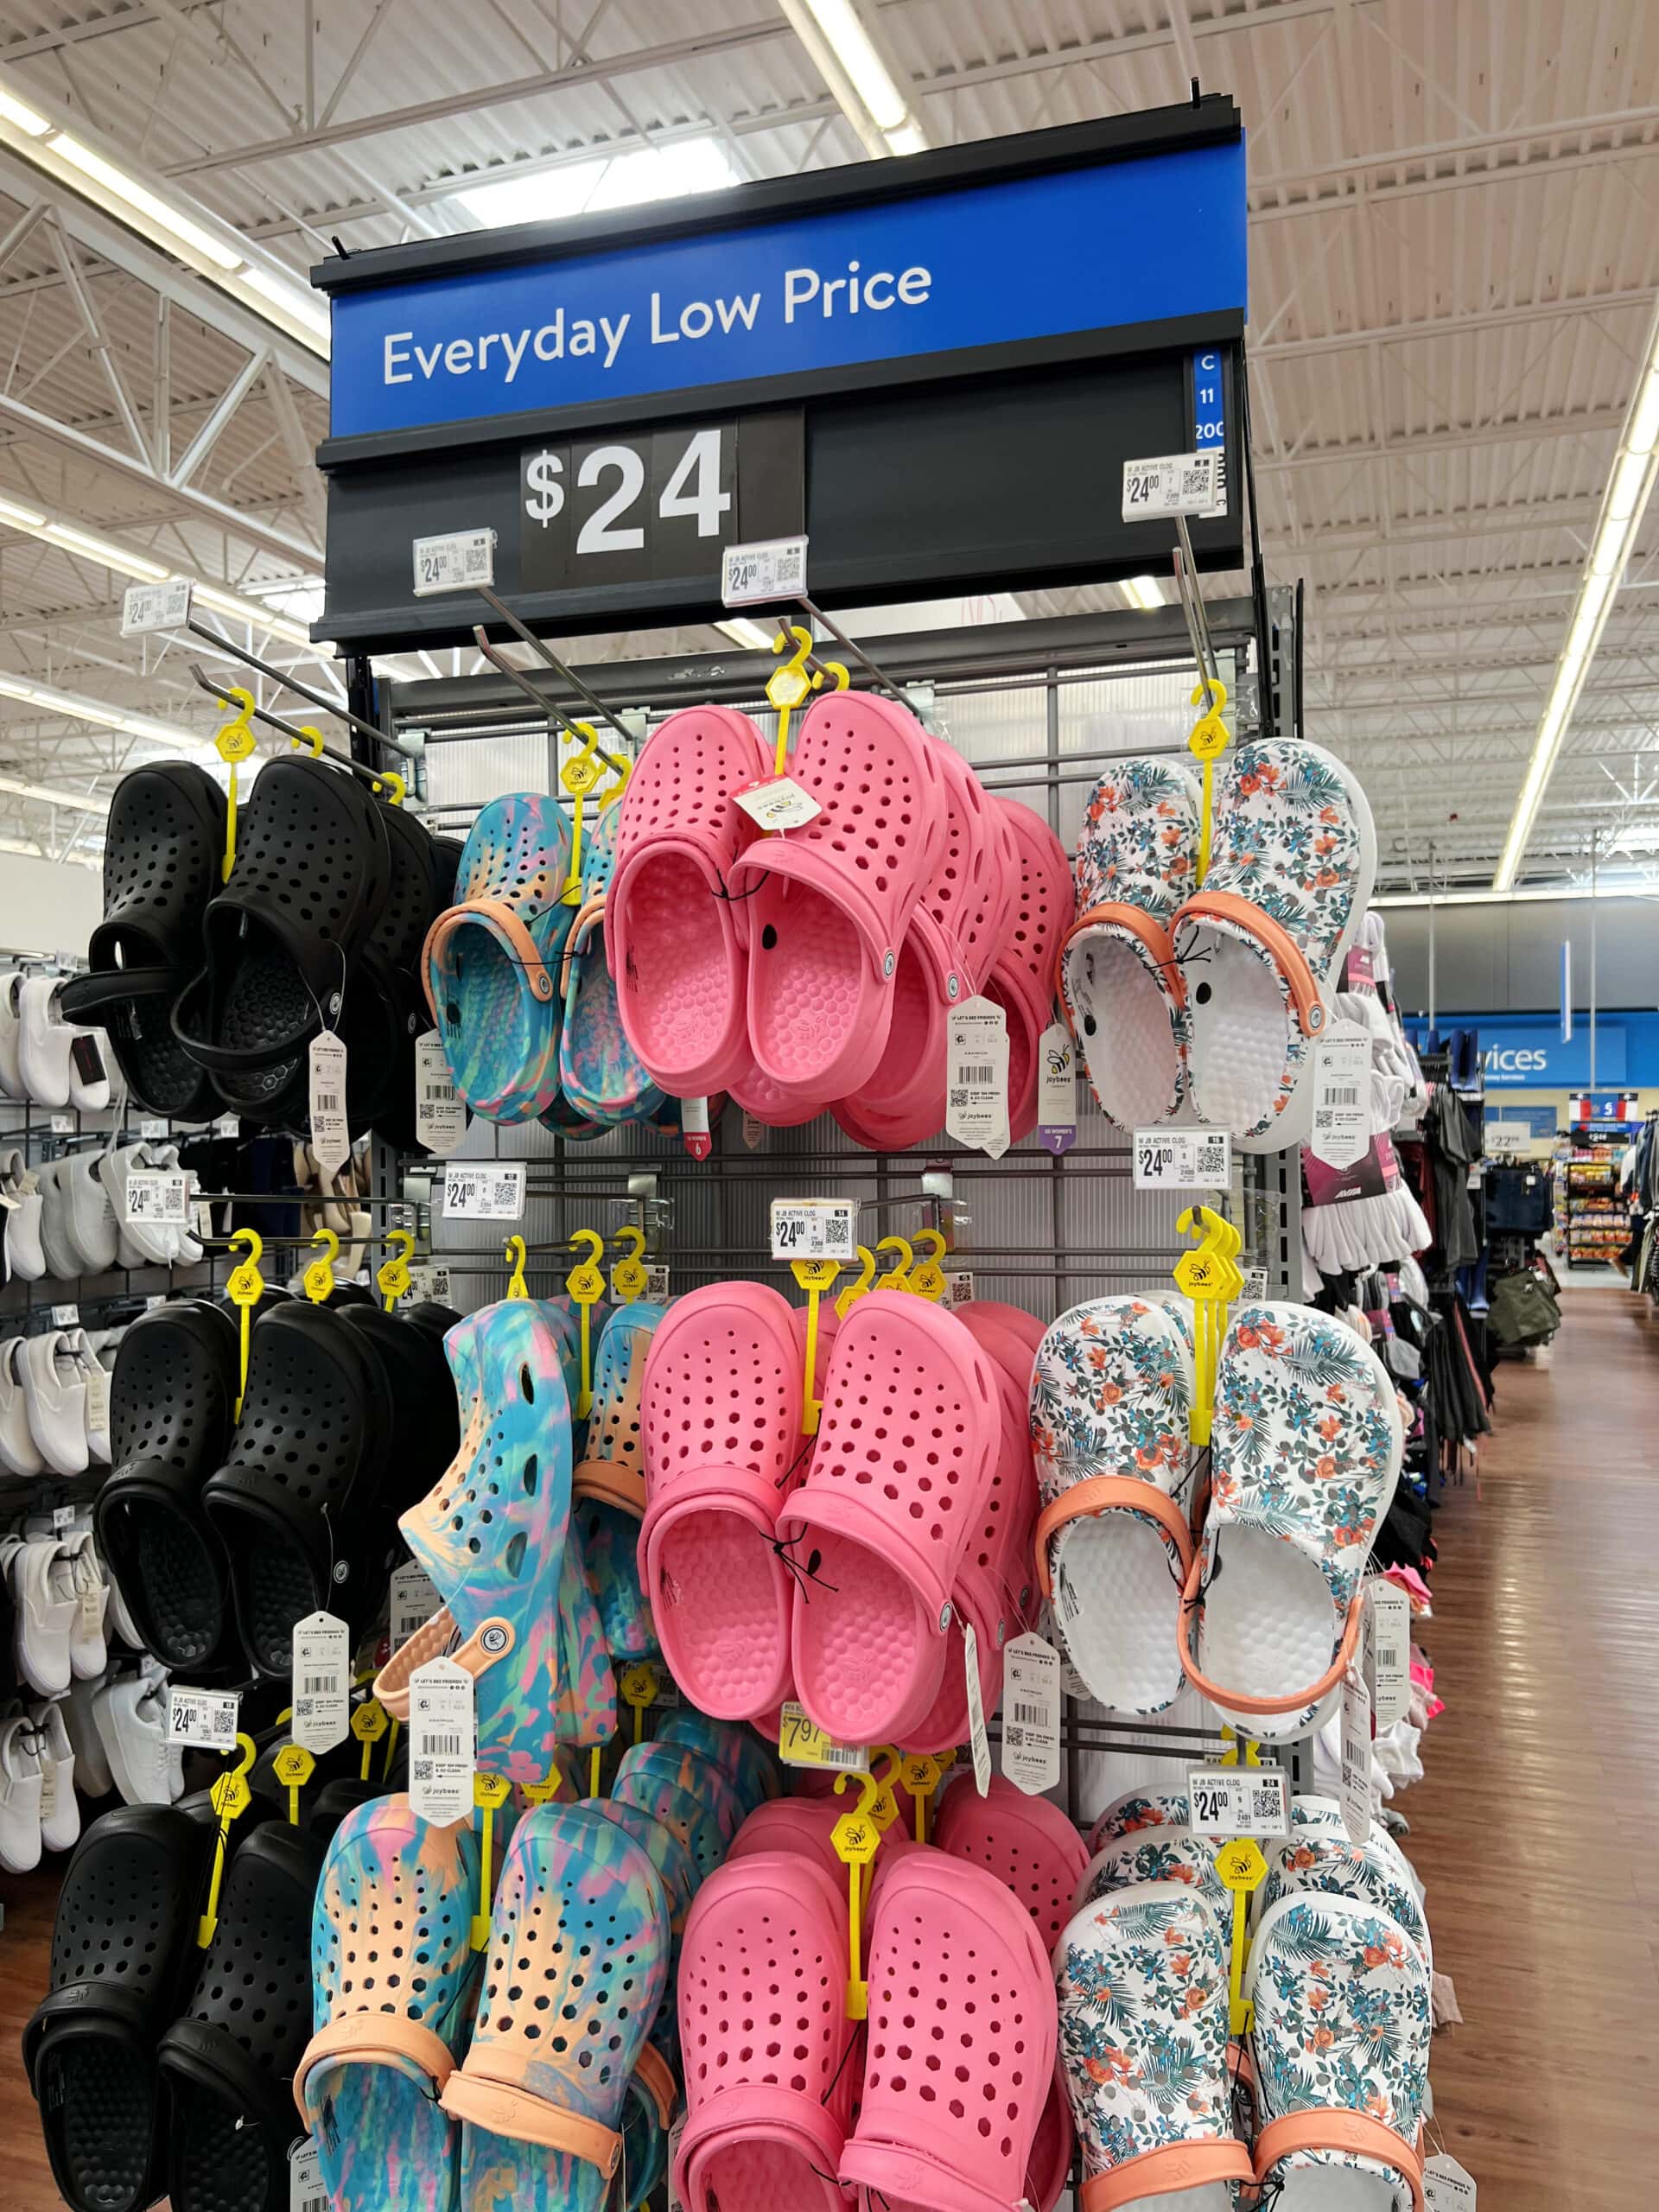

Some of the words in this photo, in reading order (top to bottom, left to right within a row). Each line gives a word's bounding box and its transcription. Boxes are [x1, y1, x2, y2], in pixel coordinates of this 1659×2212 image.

[383, 307, 631, 385] Everyday
[650, 292, 761, 345] Low
[784, 261, 932, 324] Price
[1201, 354, 1215, 371] C
[1199, 388, 1214, 404] 11
[524, 429, 732, 555] $24
[696, 1142, 702, 1155] 6
[1054, 1135, 1062, 1149] 7
